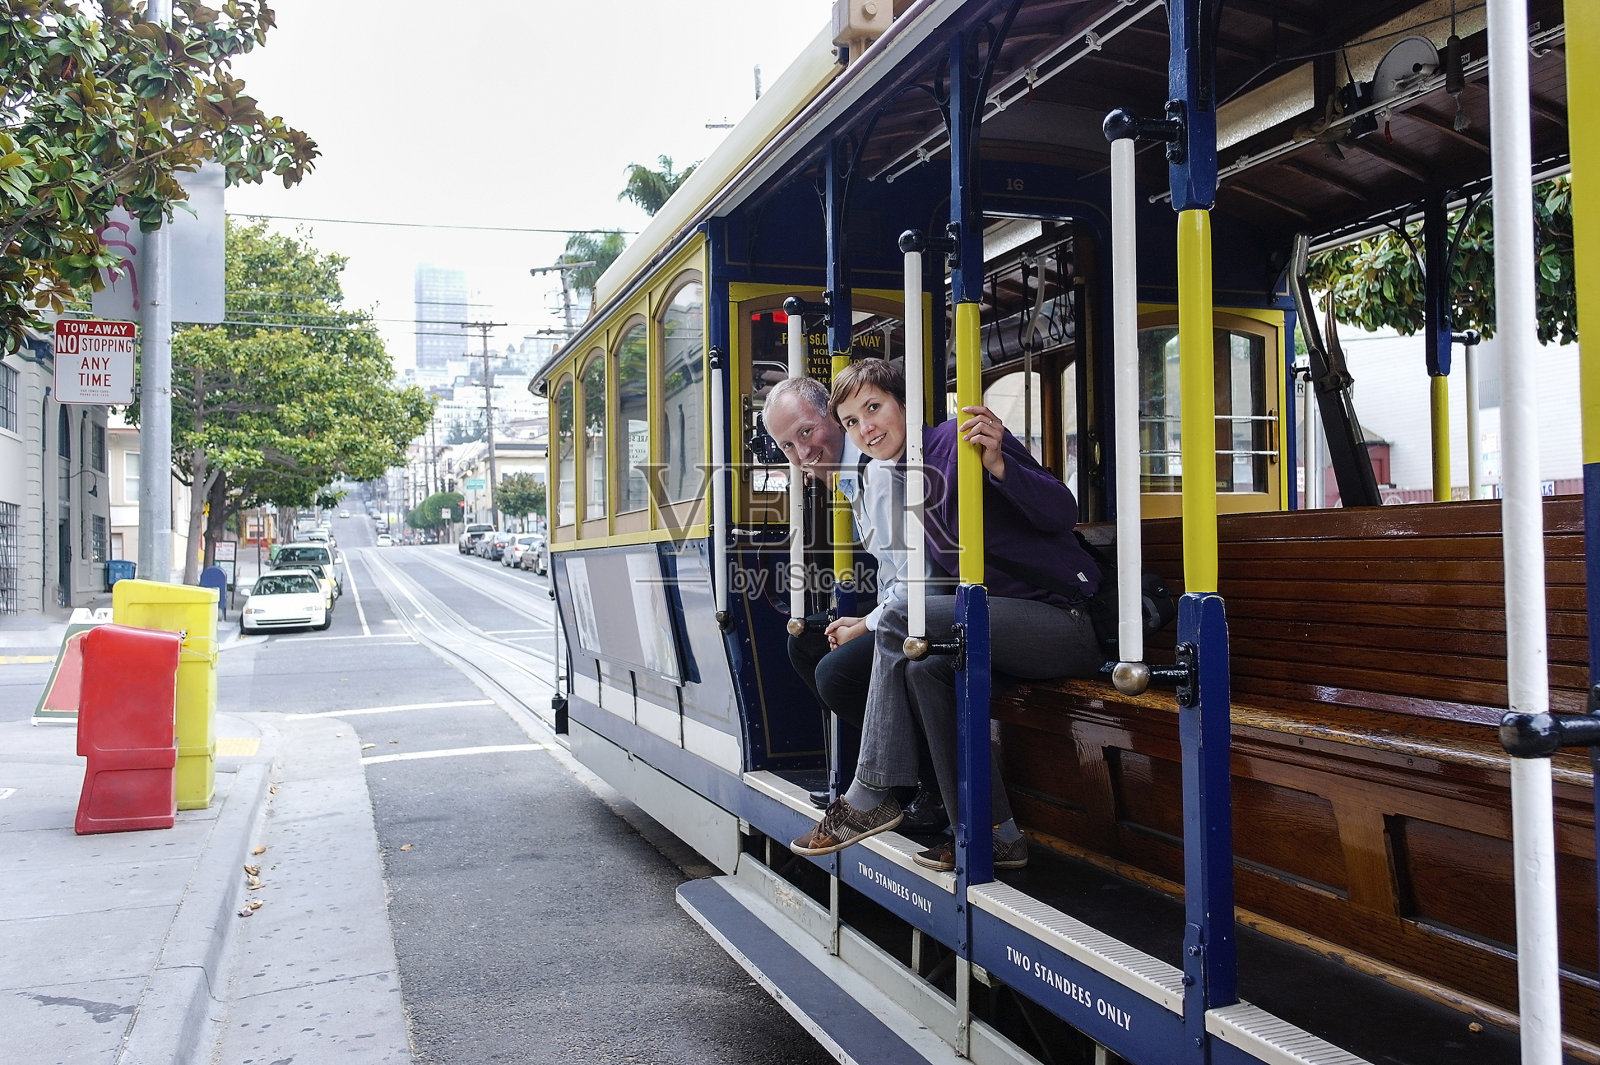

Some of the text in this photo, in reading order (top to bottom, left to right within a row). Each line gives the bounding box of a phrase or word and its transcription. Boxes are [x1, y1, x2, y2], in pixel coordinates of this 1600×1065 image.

[1007, 178, 1024, 191] 16
[64, 323, 128, 335] TOW-AWAY
[57, 334, 132, 353] NO STOPPING
[809, 333, 828, 346] $6.0
[860, 335, 881, 348] WAY
[81, 356, 110, 370] ANY
[78, 372, 112, 387] TIME
[858, 861, 932, 914] TWO STANDEES ONLY
[1006, 945, 1131, 1031] TWO STANDEES ONLY
